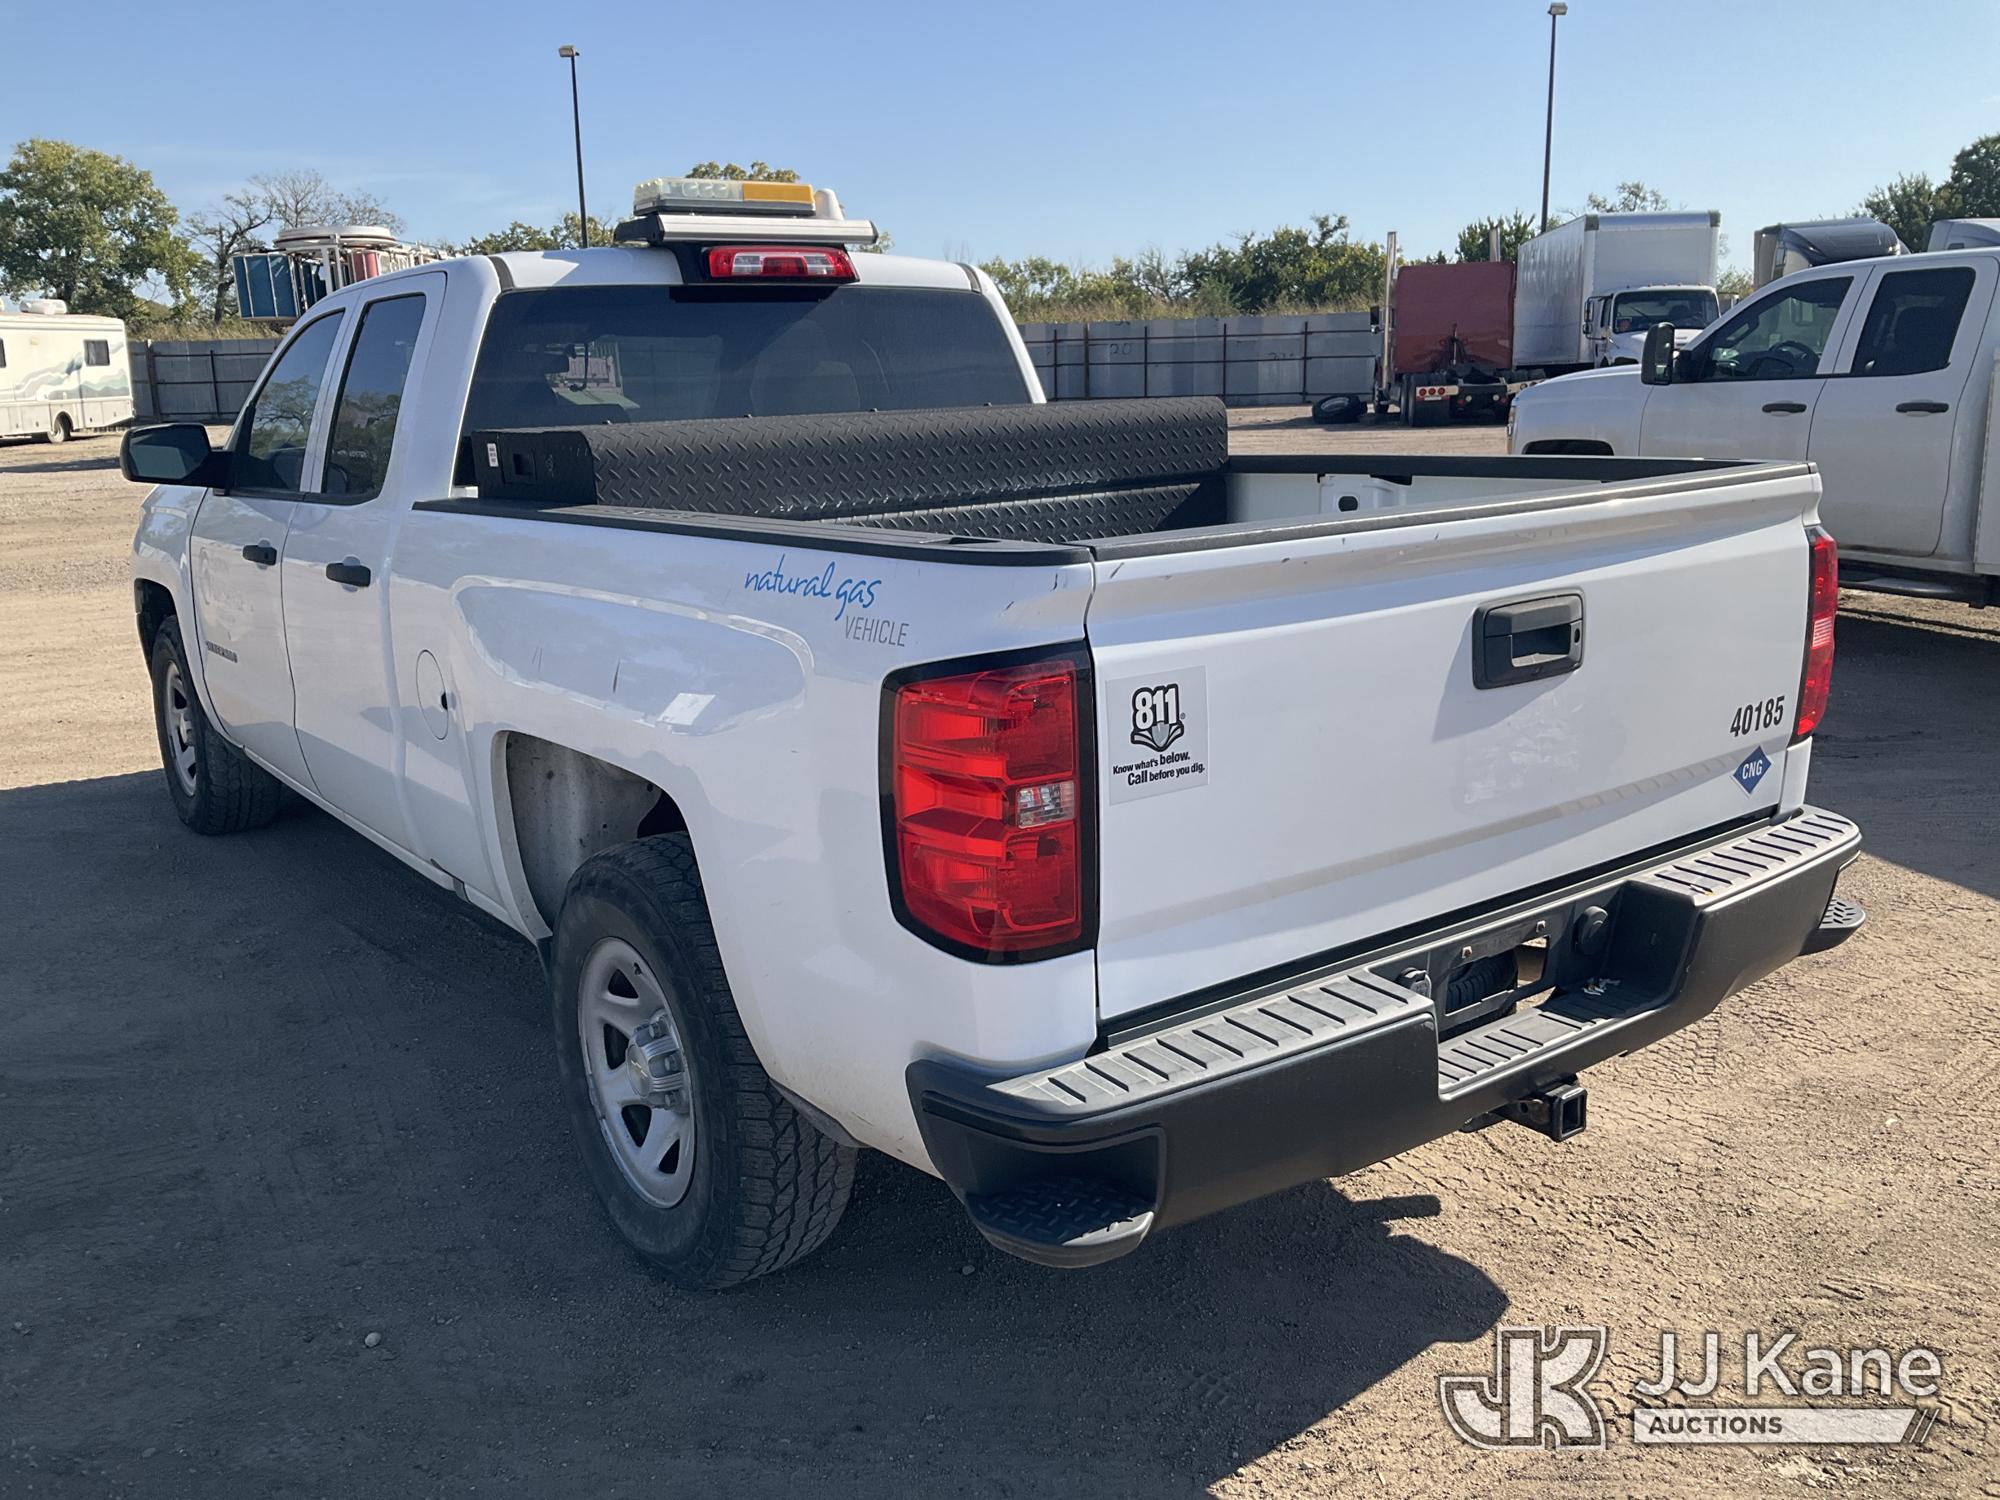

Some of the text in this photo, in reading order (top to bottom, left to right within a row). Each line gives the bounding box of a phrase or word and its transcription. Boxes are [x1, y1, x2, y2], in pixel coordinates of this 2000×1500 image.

[745, 554, 882, 621] natural gas
[845, 615, 910, 647] VEHICLE
[1132, 684, 1180, 731] 811
[1730, 695, 1785, 737] 40185
[1113, 752, 1191, 775] Know what's below.
[1127, 762, 1205, 786] Call before you dig.
[1742, 759, 1763, 780] CNG
